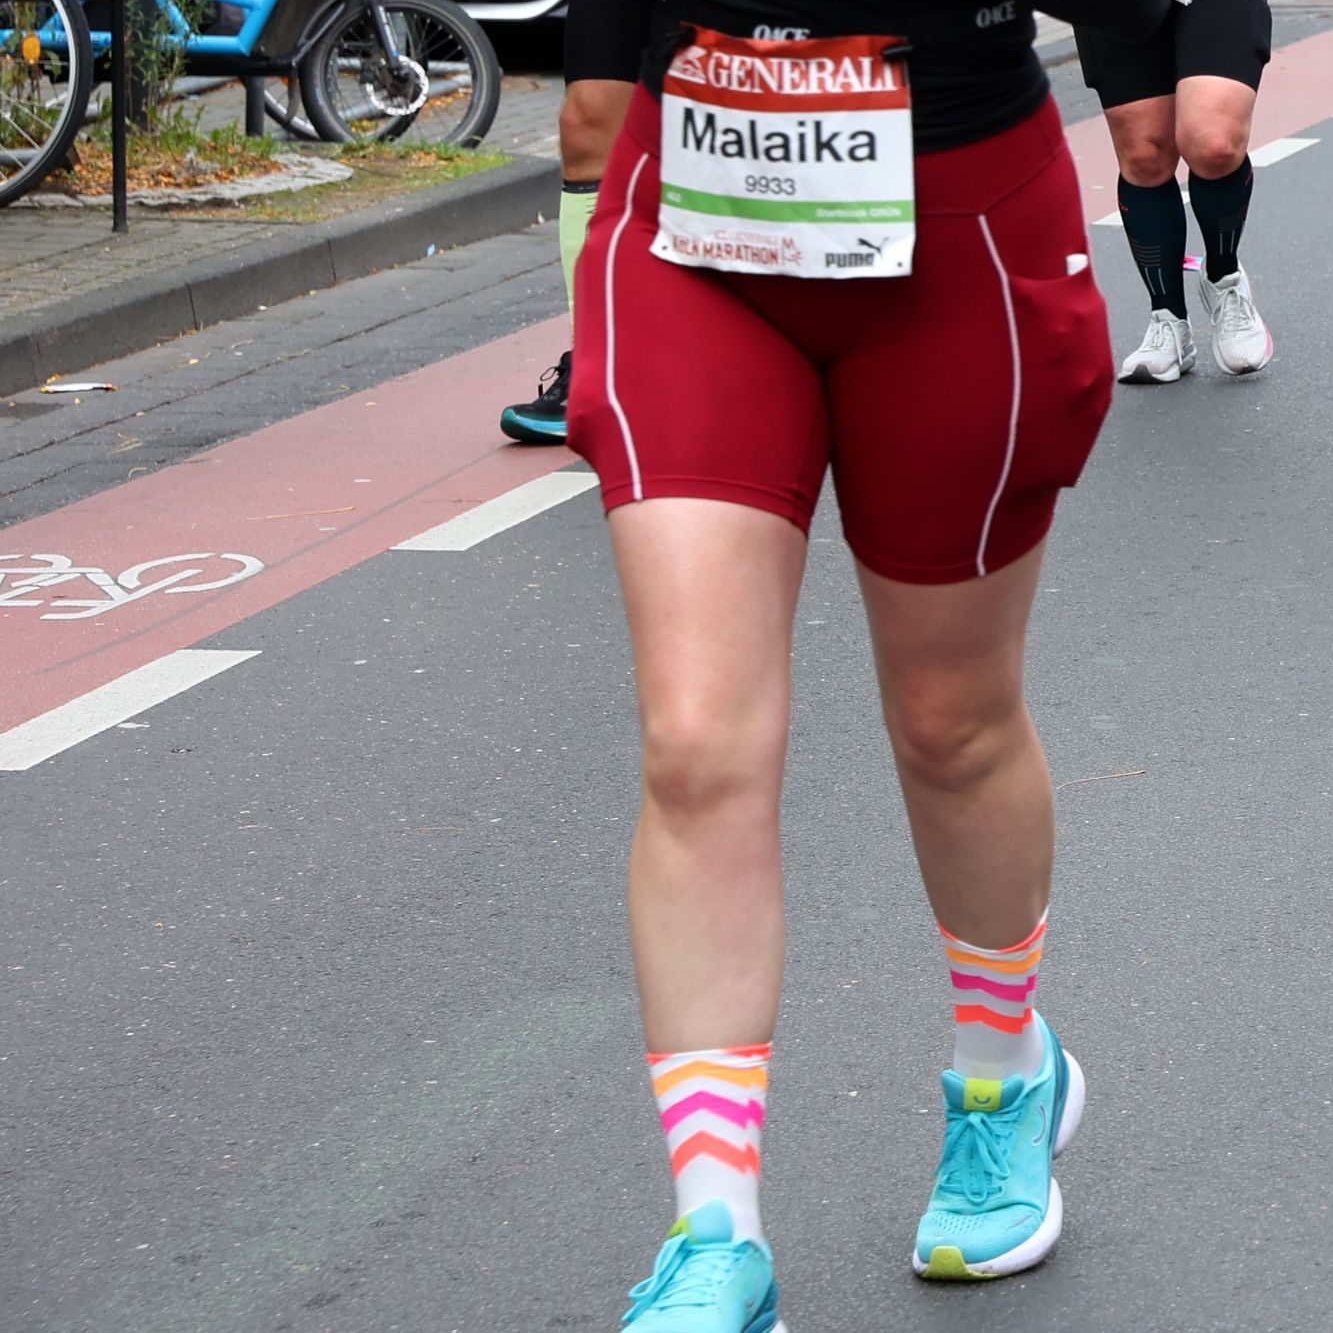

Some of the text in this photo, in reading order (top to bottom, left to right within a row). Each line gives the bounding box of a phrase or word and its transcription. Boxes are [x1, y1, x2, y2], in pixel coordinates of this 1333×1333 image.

[707, 52, 899, 95] GENERALI
[683, 106, 879, 163] Malaika
[745, 174, 798, 196] 9933
[702, 242, 780, 266] MARATHON
[825, 252, 875, 269] PUMA
